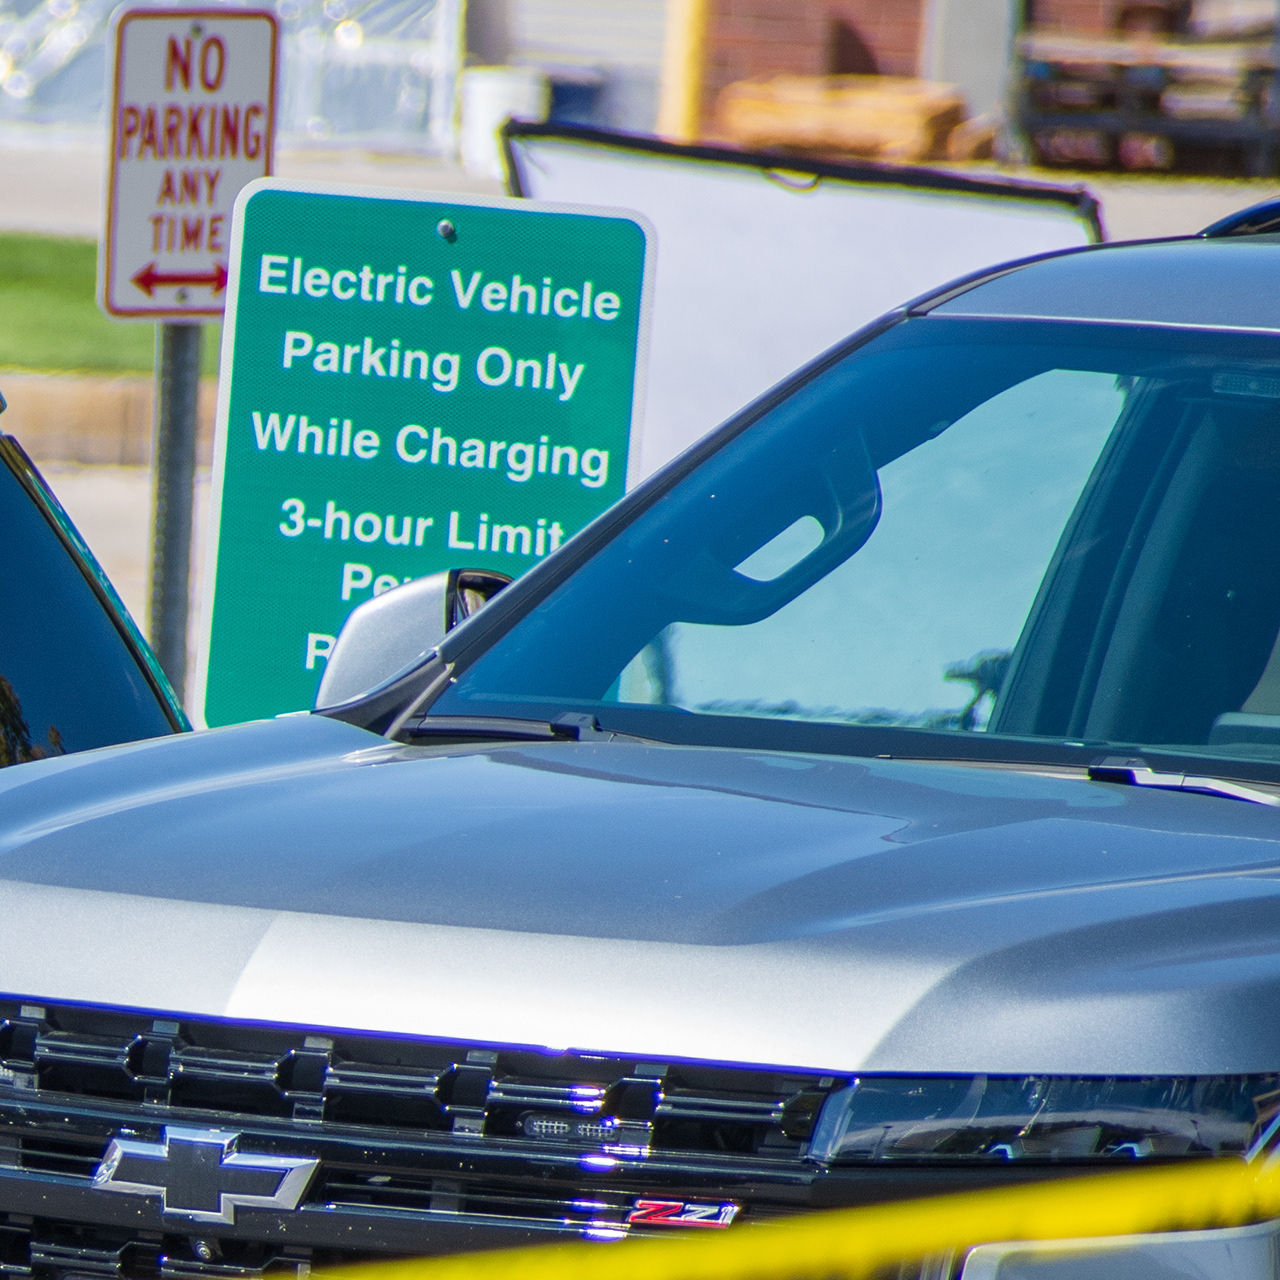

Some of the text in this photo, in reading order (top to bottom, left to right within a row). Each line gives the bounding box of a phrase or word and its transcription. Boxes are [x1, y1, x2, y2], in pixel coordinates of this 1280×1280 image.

[164, 36, 226, 93] NO
[120, 104, 263, 161] PARKING
[156, 169, 221, 207] ANY
[149, 214, 225, 254] TIME
[259, 253, 622, 321] Electric Vehicle
[282, 330, 585, 402] Parking Only
[251, 411, 610, 488] While Charging
[279, 497, 565, 556] 3-hour Limit
